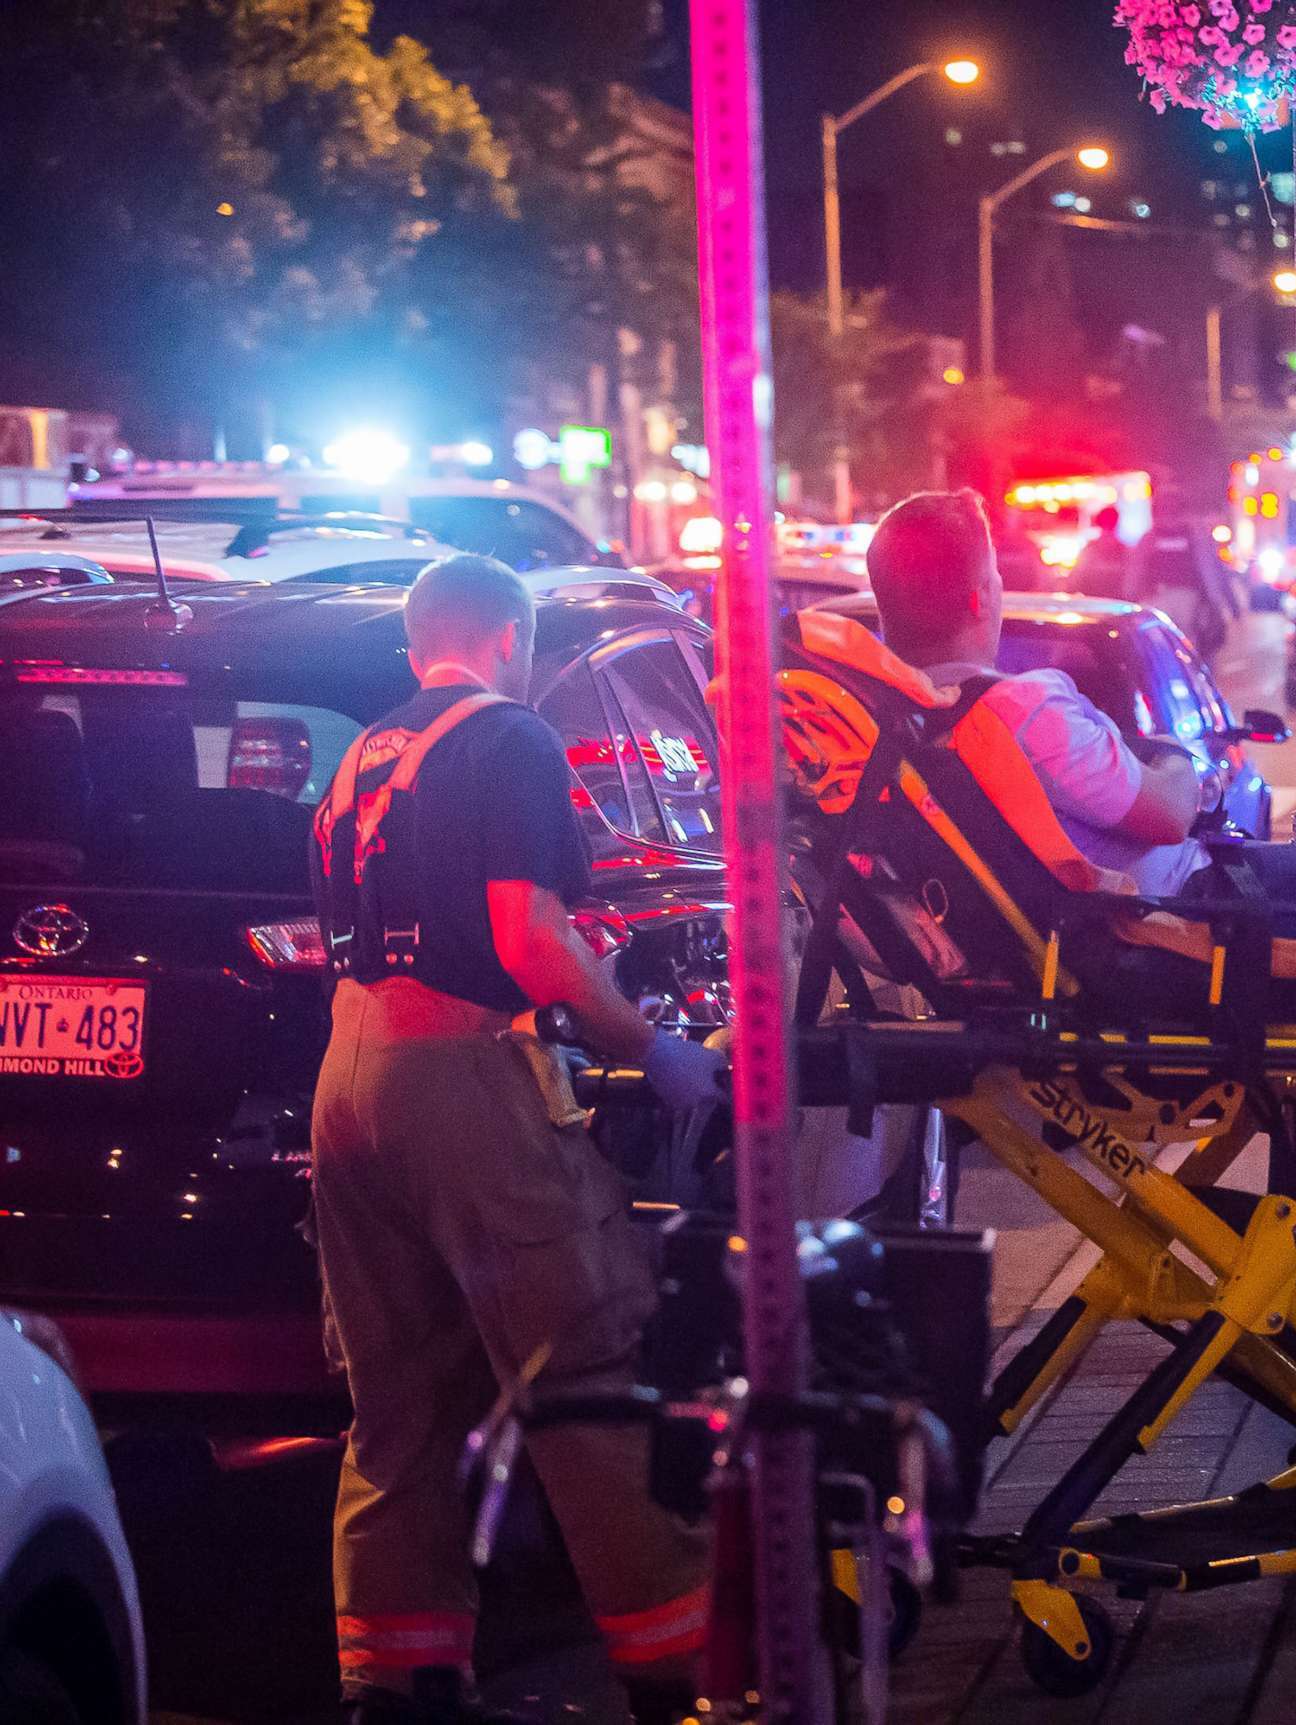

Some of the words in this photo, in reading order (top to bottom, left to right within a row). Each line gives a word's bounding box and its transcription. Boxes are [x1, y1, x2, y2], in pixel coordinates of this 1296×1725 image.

[19, 985, 93, 1000] ONTARIO
[75, 1005, 139, 1052] 483
[64, 1059, 106, 1077] HILL
[1028, 1079, 1146, 1178] stryker
